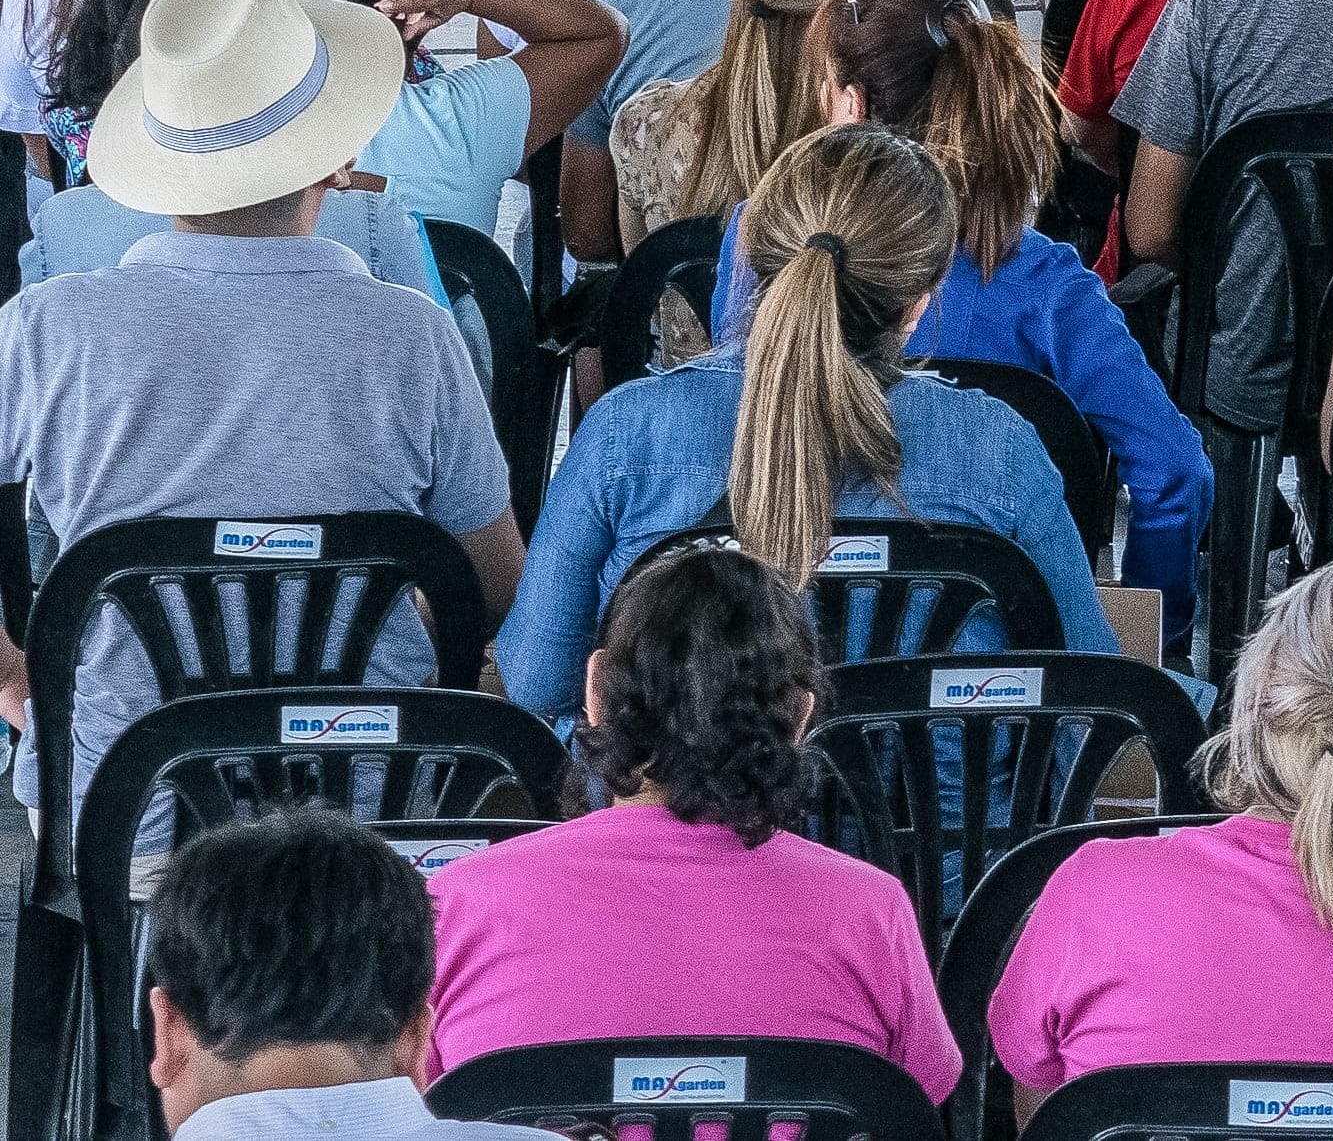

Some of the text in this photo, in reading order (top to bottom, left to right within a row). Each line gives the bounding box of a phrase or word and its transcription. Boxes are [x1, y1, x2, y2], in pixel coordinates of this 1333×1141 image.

[222, 533, 314, 549] MAXgarden
[947, 684, 1027, 698] MAXgarden
[289, 719, 390, 733] MAXgarden
[632, 1076, 726, 1092] MAXgarden
